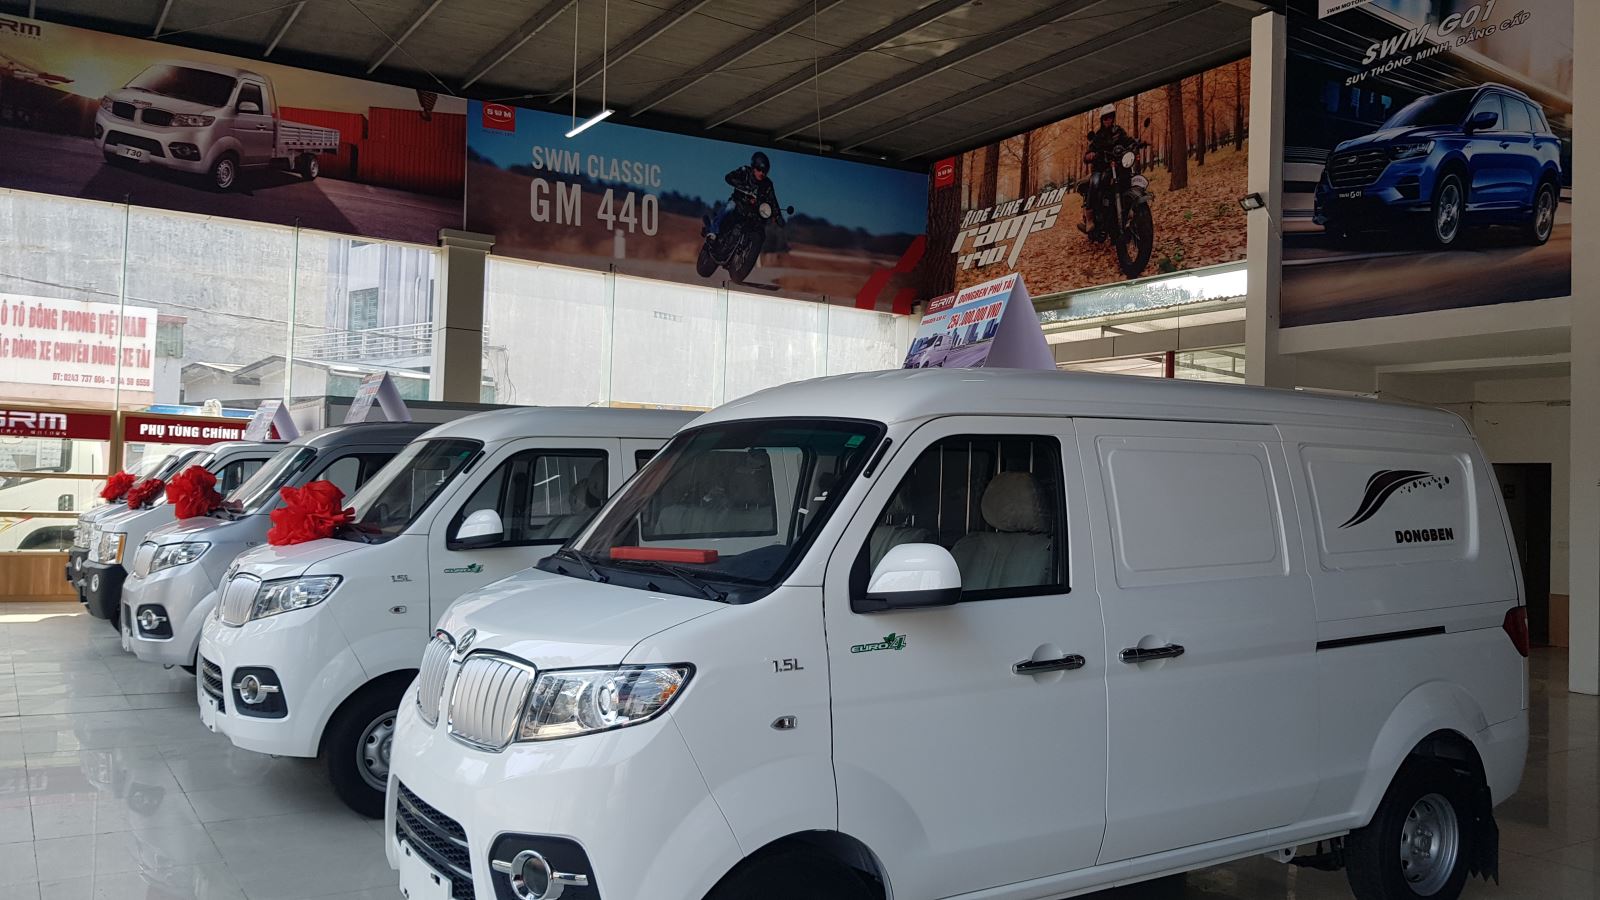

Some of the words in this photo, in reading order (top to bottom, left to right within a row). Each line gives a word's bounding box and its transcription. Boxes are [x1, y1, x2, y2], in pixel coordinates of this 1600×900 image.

[1341, 0, 1366, 9] MOTO
[1361, 23, 1431, 65] SWM
[1436, 0, 1497, 36] G01
[1345, 70, 1369, 86] SUV
[1371, 56, 1412, 77] THÔNG
[1499, 10, 1532, 31] CẤP
[126, 148, 142, 158] T30
[532, 145, 580, 175] SWM
[587, 154, 661, 188] CLASSIC
[530, 177, 582, 226] GM
[597, 188, 659, 236] 440
[960, 207, 992, 229] RIDE
[991, 198, 1024, 219] LIKE
[1037, 186, 1067, 207] MAN
[61, 310, 96, 333] PHONG
[40, 340, 51, 360] XE
[122, 347, 133, 367] XE
[140, 423, 165, 438] PHỤ
[167, 424, 199, 438] TÙNG
[202, 426, 239, 440] CHÍNH
[1395, 527, 1454, 544] DONGBEN
[772, 658, 804, 673] 1.5L
